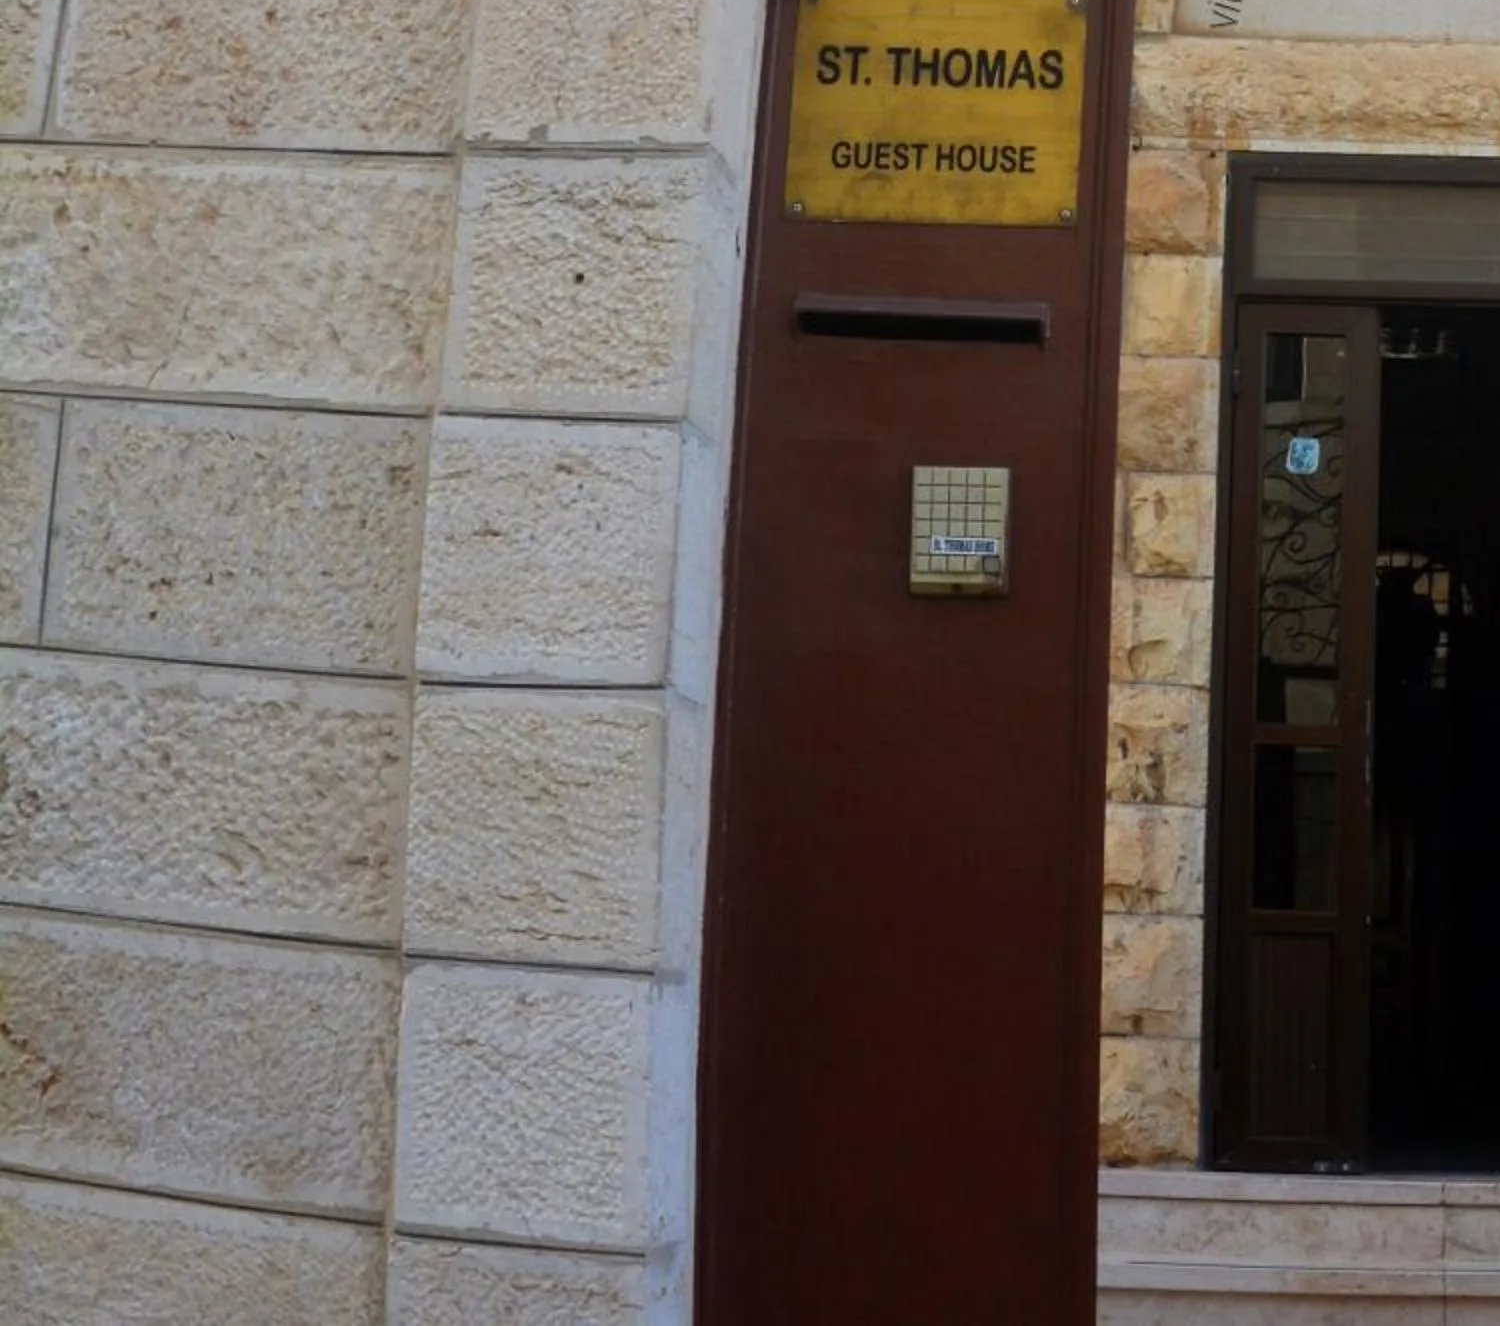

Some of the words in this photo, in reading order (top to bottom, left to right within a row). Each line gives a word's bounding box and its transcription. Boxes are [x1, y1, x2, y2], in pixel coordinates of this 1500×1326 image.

[816, 45, 871, 86] ST.
[887, 47, 1064, 90] THOMAS
[831, 141, 928, 170] GUEST
[936, 144, 1037, 174] HOUSE
